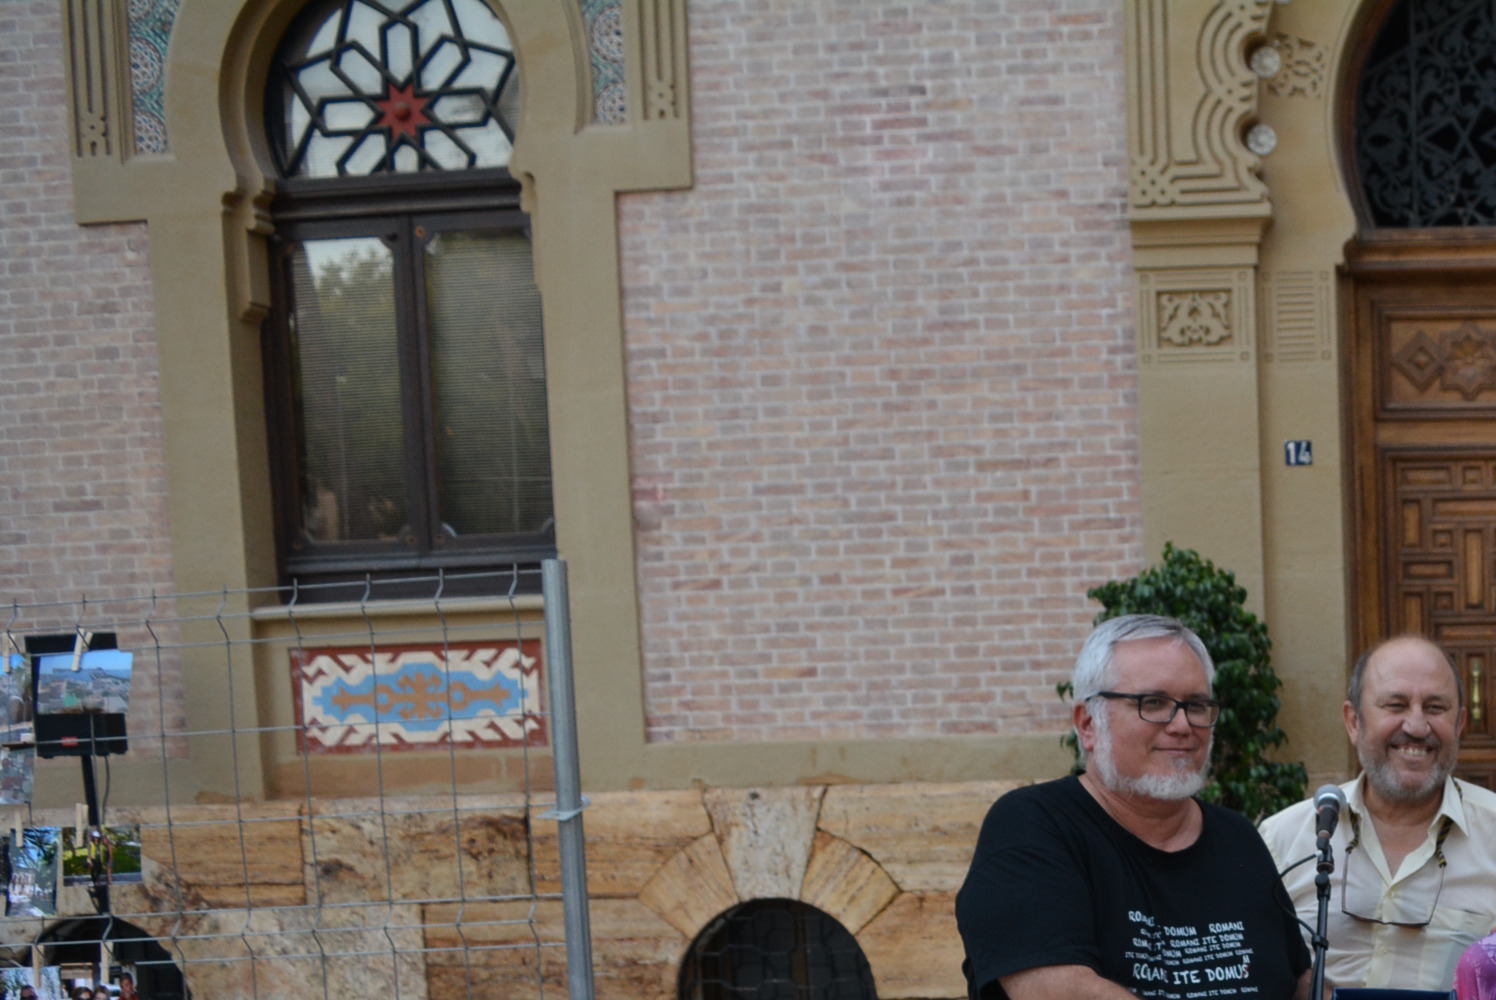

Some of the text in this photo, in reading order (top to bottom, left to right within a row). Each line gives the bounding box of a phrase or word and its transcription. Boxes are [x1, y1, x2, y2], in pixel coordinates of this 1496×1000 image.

[1287, 442, 1312, 466] 14
[1163, 926, 1198, 937] DOMUM
[1208, 921, 1245, 934] ROMANI
[1202, 935, 1218, 945] ITE
[1172, 969, 1202, 985] ITE
